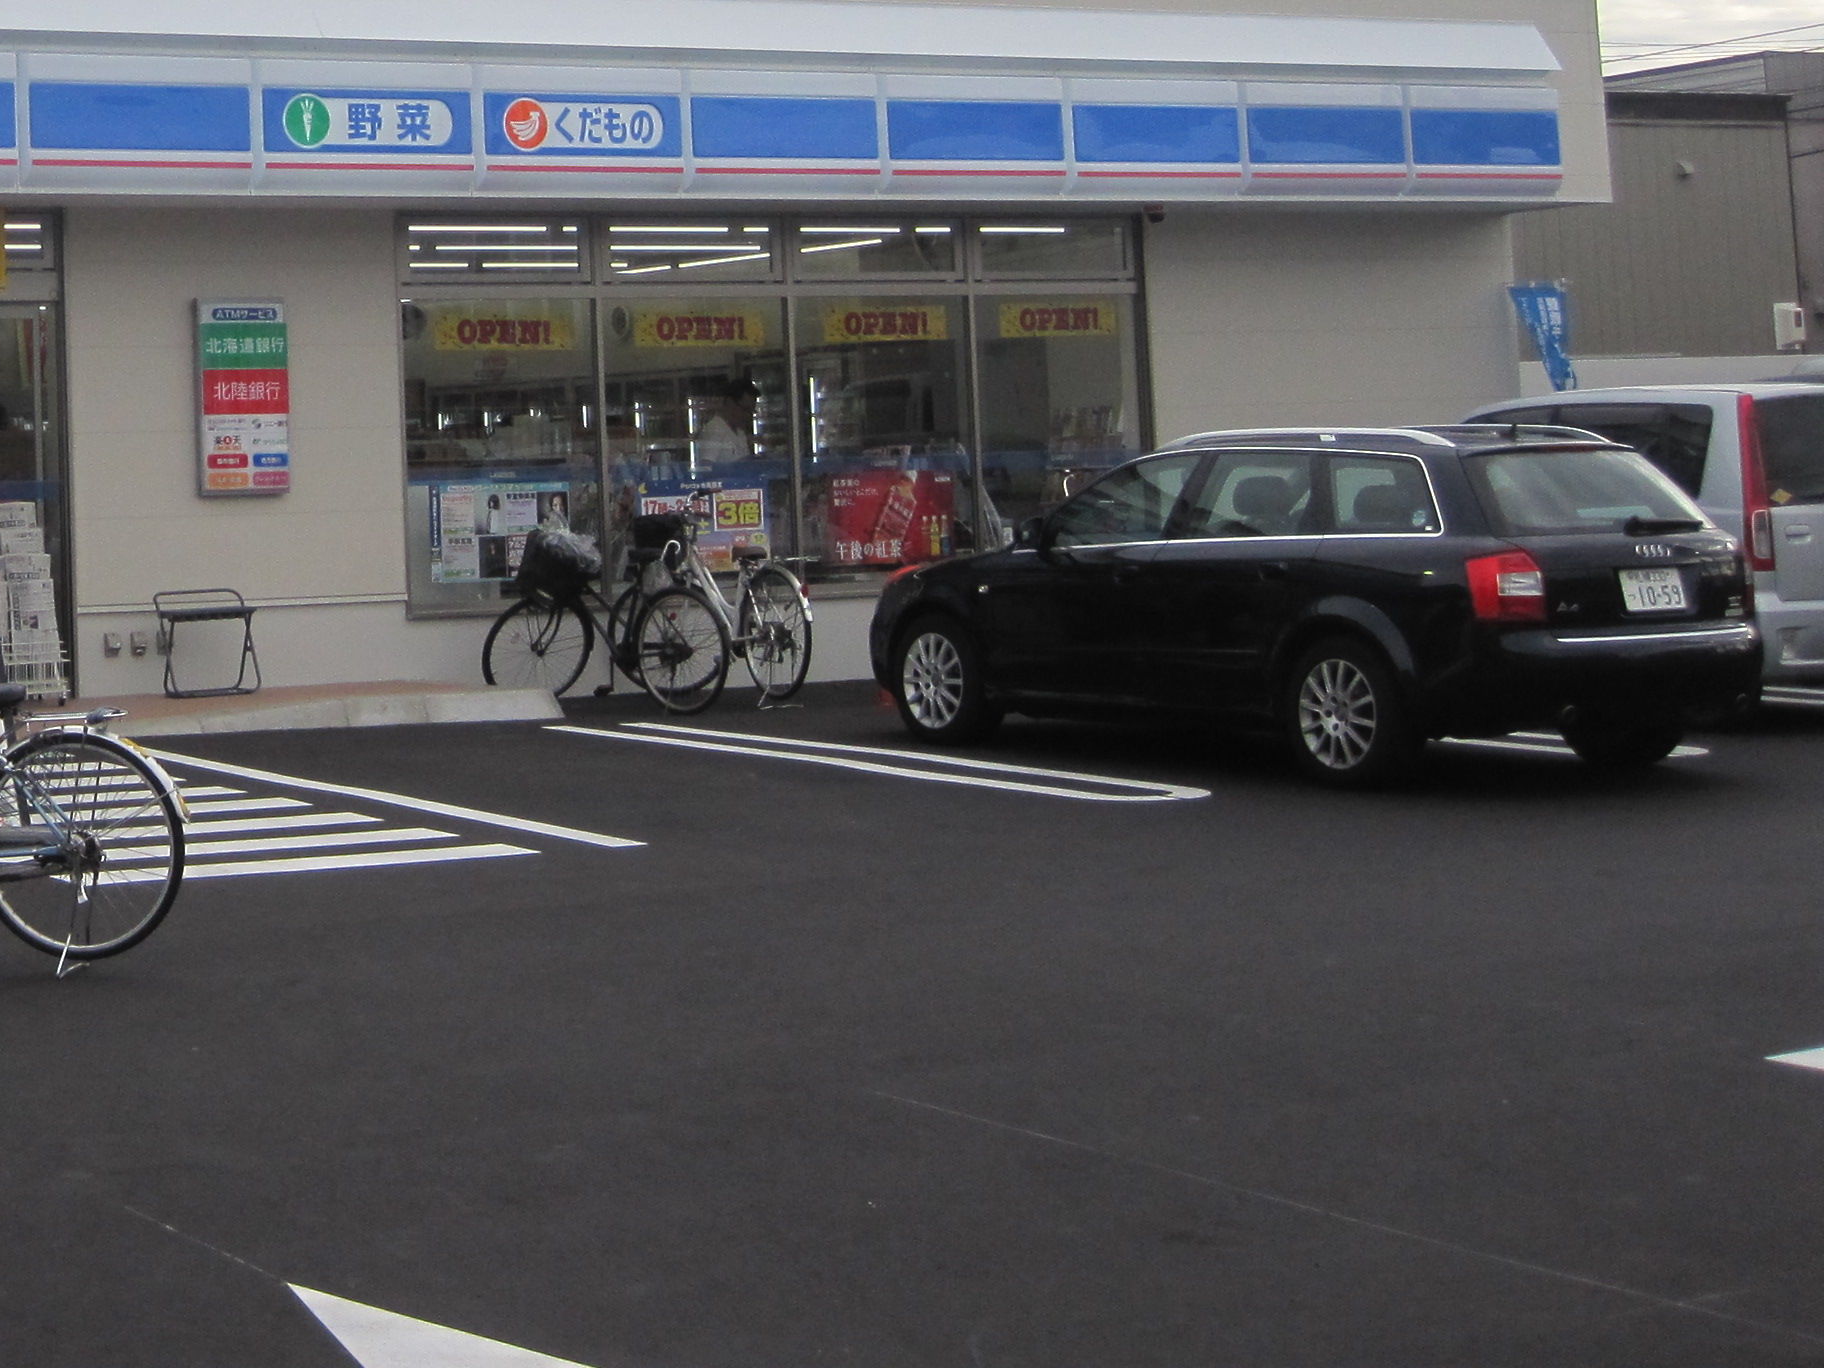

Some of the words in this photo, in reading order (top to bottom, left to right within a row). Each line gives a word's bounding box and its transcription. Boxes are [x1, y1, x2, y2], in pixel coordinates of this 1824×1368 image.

[347, 102, 432, 143] 野菜
[554, 107, 656, 145] くだもの
[656, 316, 744, 340] OPEN!
[843, 311, 928, 335] OPEN!
[1019, 307, 1098, 331] OPEN!
[457, 319, 551, 345] OPEN!
[205, 337, 285, 354] 北海道銀行
[213, 381, 281, 400] 北陸銀行
[718, 501, 760, 526] 3倍
[835, 539, 903, 561] 午後の紅茶
[1638, 584, 1682, 608] 10-59
